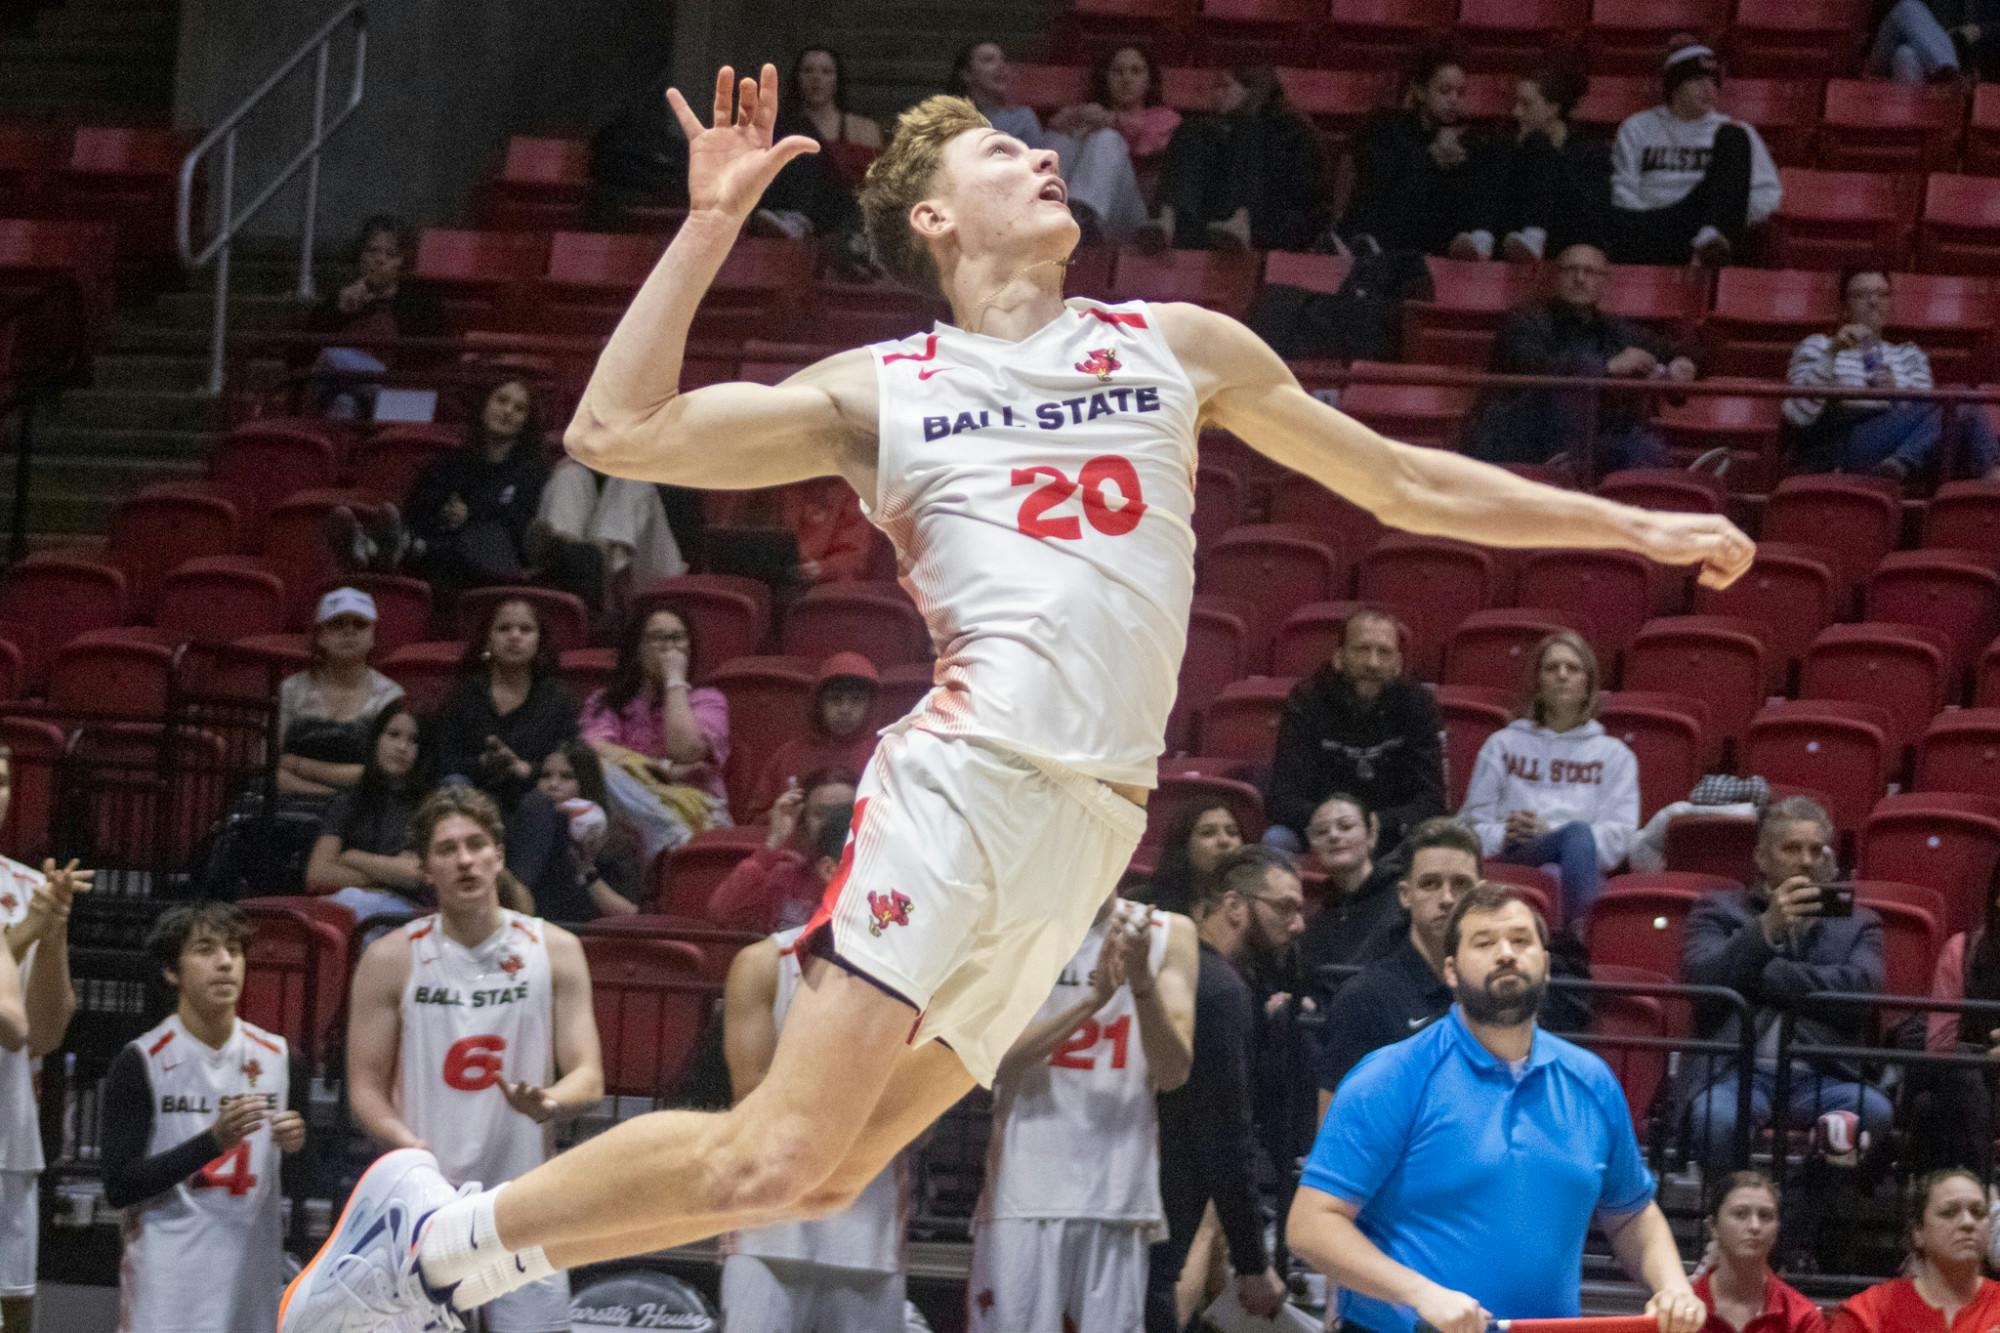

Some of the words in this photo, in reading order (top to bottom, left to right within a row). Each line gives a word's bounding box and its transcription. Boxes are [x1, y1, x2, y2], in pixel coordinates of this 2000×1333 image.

[923, 405, 1026, 442] BALL
[1036, 386, 1161, 430] STATE
[1011, 454, 1148, 541] 20
[414, 985, 464, 1006] BALL
[443, 1034, 507, 1092] 6
[1048, 1014, 1131, 1071] 21
[161, 1094, 212, 1114] BALL
[190, 1140, 257, 1197] 4
[569, 1303, 632, 1327] arsity
[634, 1302, 713, 1332] House
